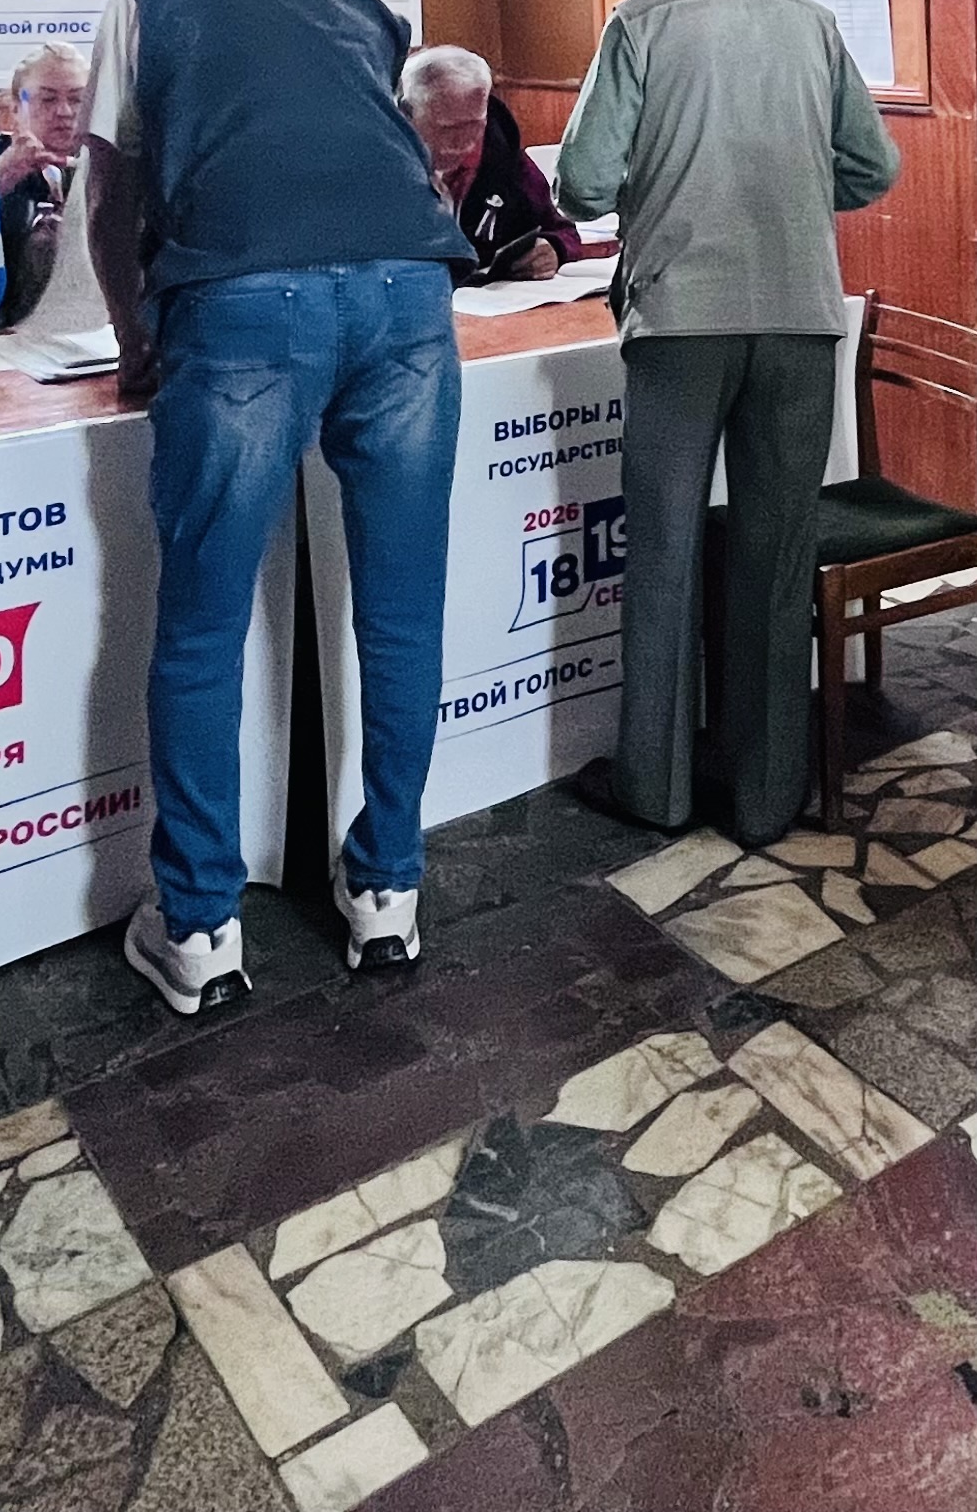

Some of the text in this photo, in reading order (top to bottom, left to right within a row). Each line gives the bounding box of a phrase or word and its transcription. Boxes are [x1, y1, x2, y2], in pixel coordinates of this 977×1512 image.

[37, 22, 92, 34] ГОЛОС
[494, 402, 600, 442] ВЫБОРЫ
[523, 502, 580, 533] 2026
[531, 553, 580, 604] 18
[439, 680, 507, 723] ТВОЙ
[514, 657, 594, 700] ГОЛОС
